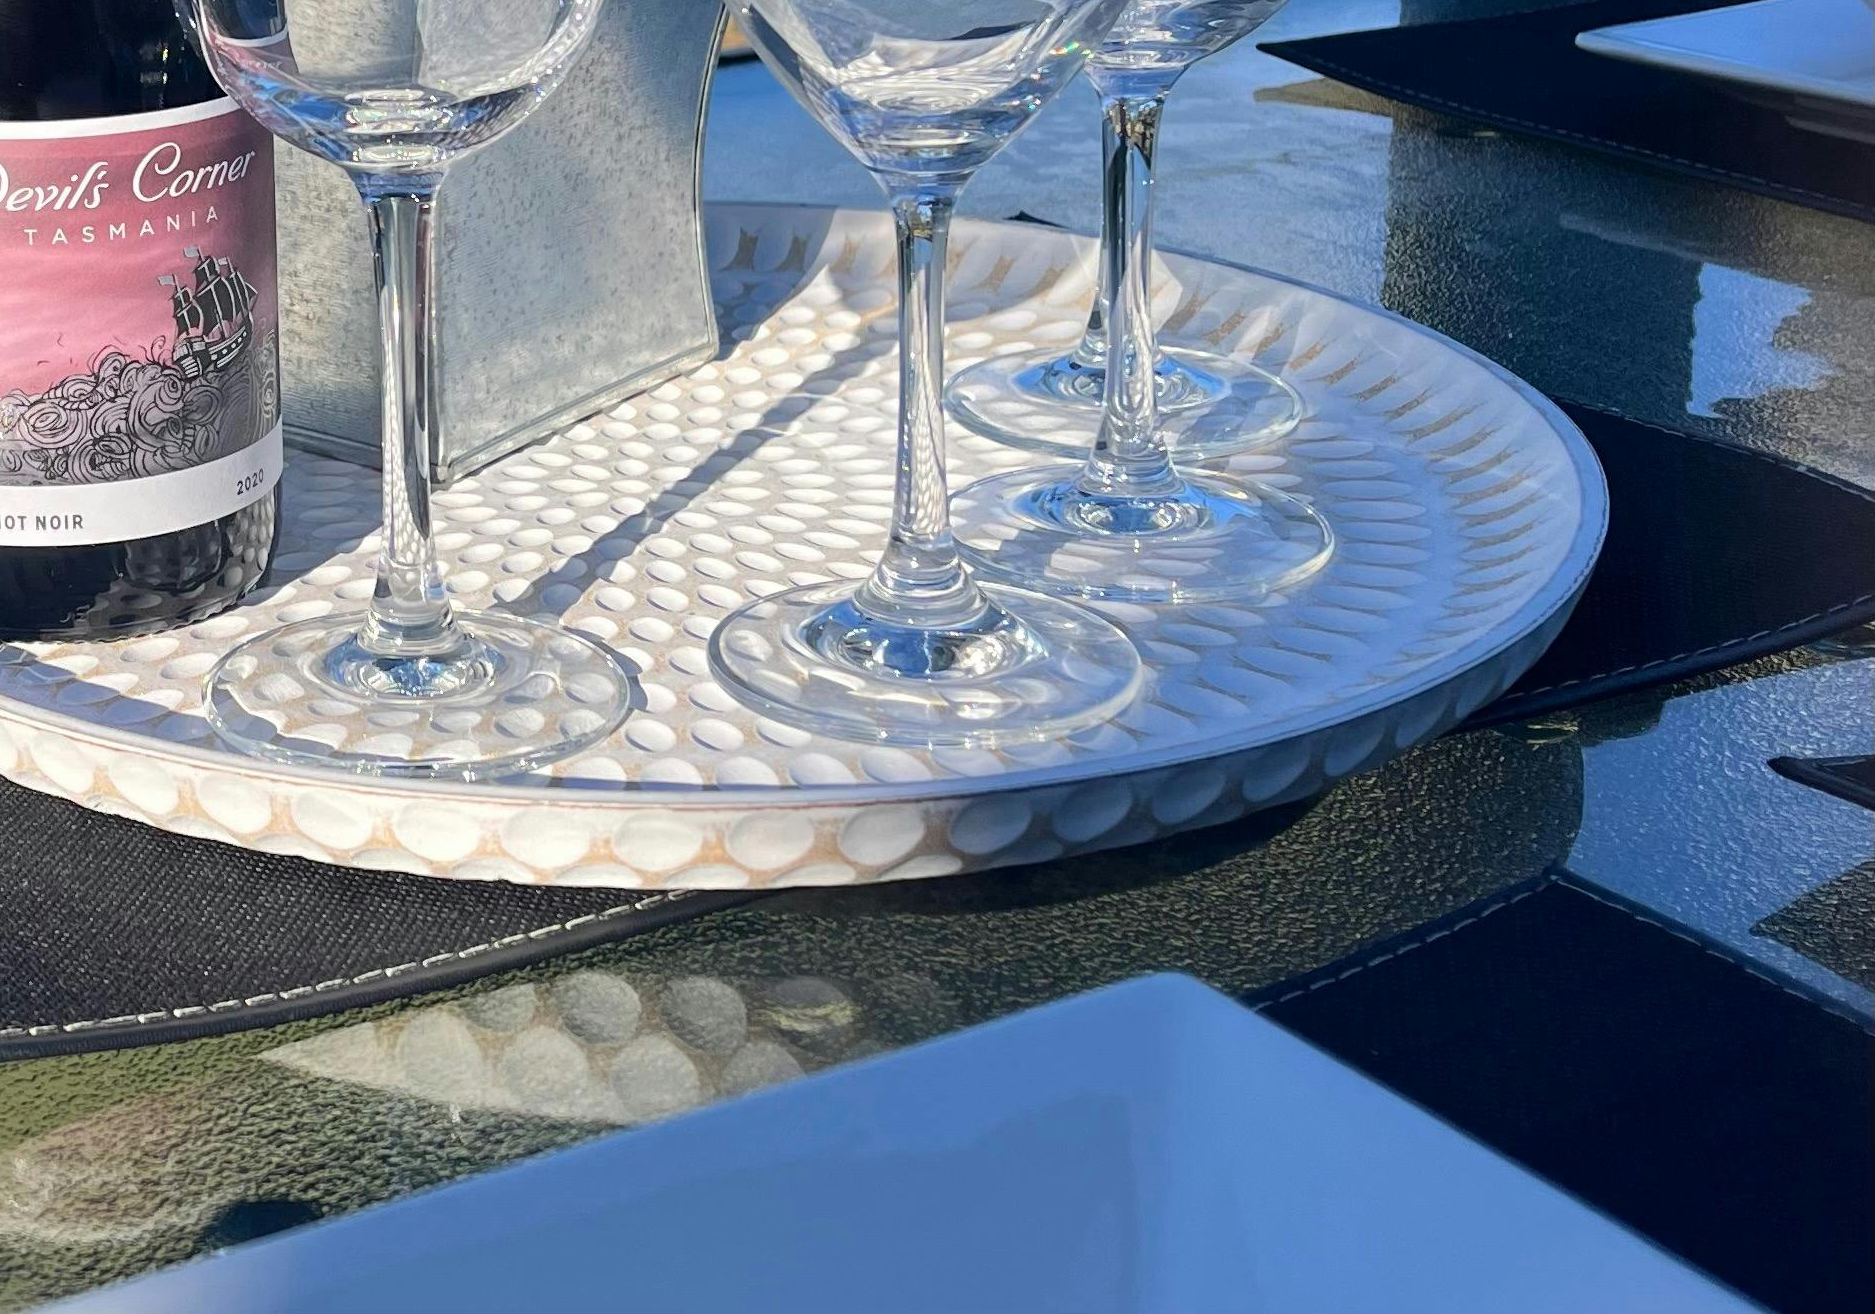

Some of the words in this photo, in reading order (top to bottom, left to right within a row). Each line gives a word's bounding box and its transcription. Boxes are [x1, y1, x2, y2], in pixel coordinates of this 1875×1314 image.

[133, 142, 256, 203] Corner
[24, 206, 219, 246] TASMANIA
[236, 468, 265, 496] 2020
[35, 514, 84, 530] NOIR
